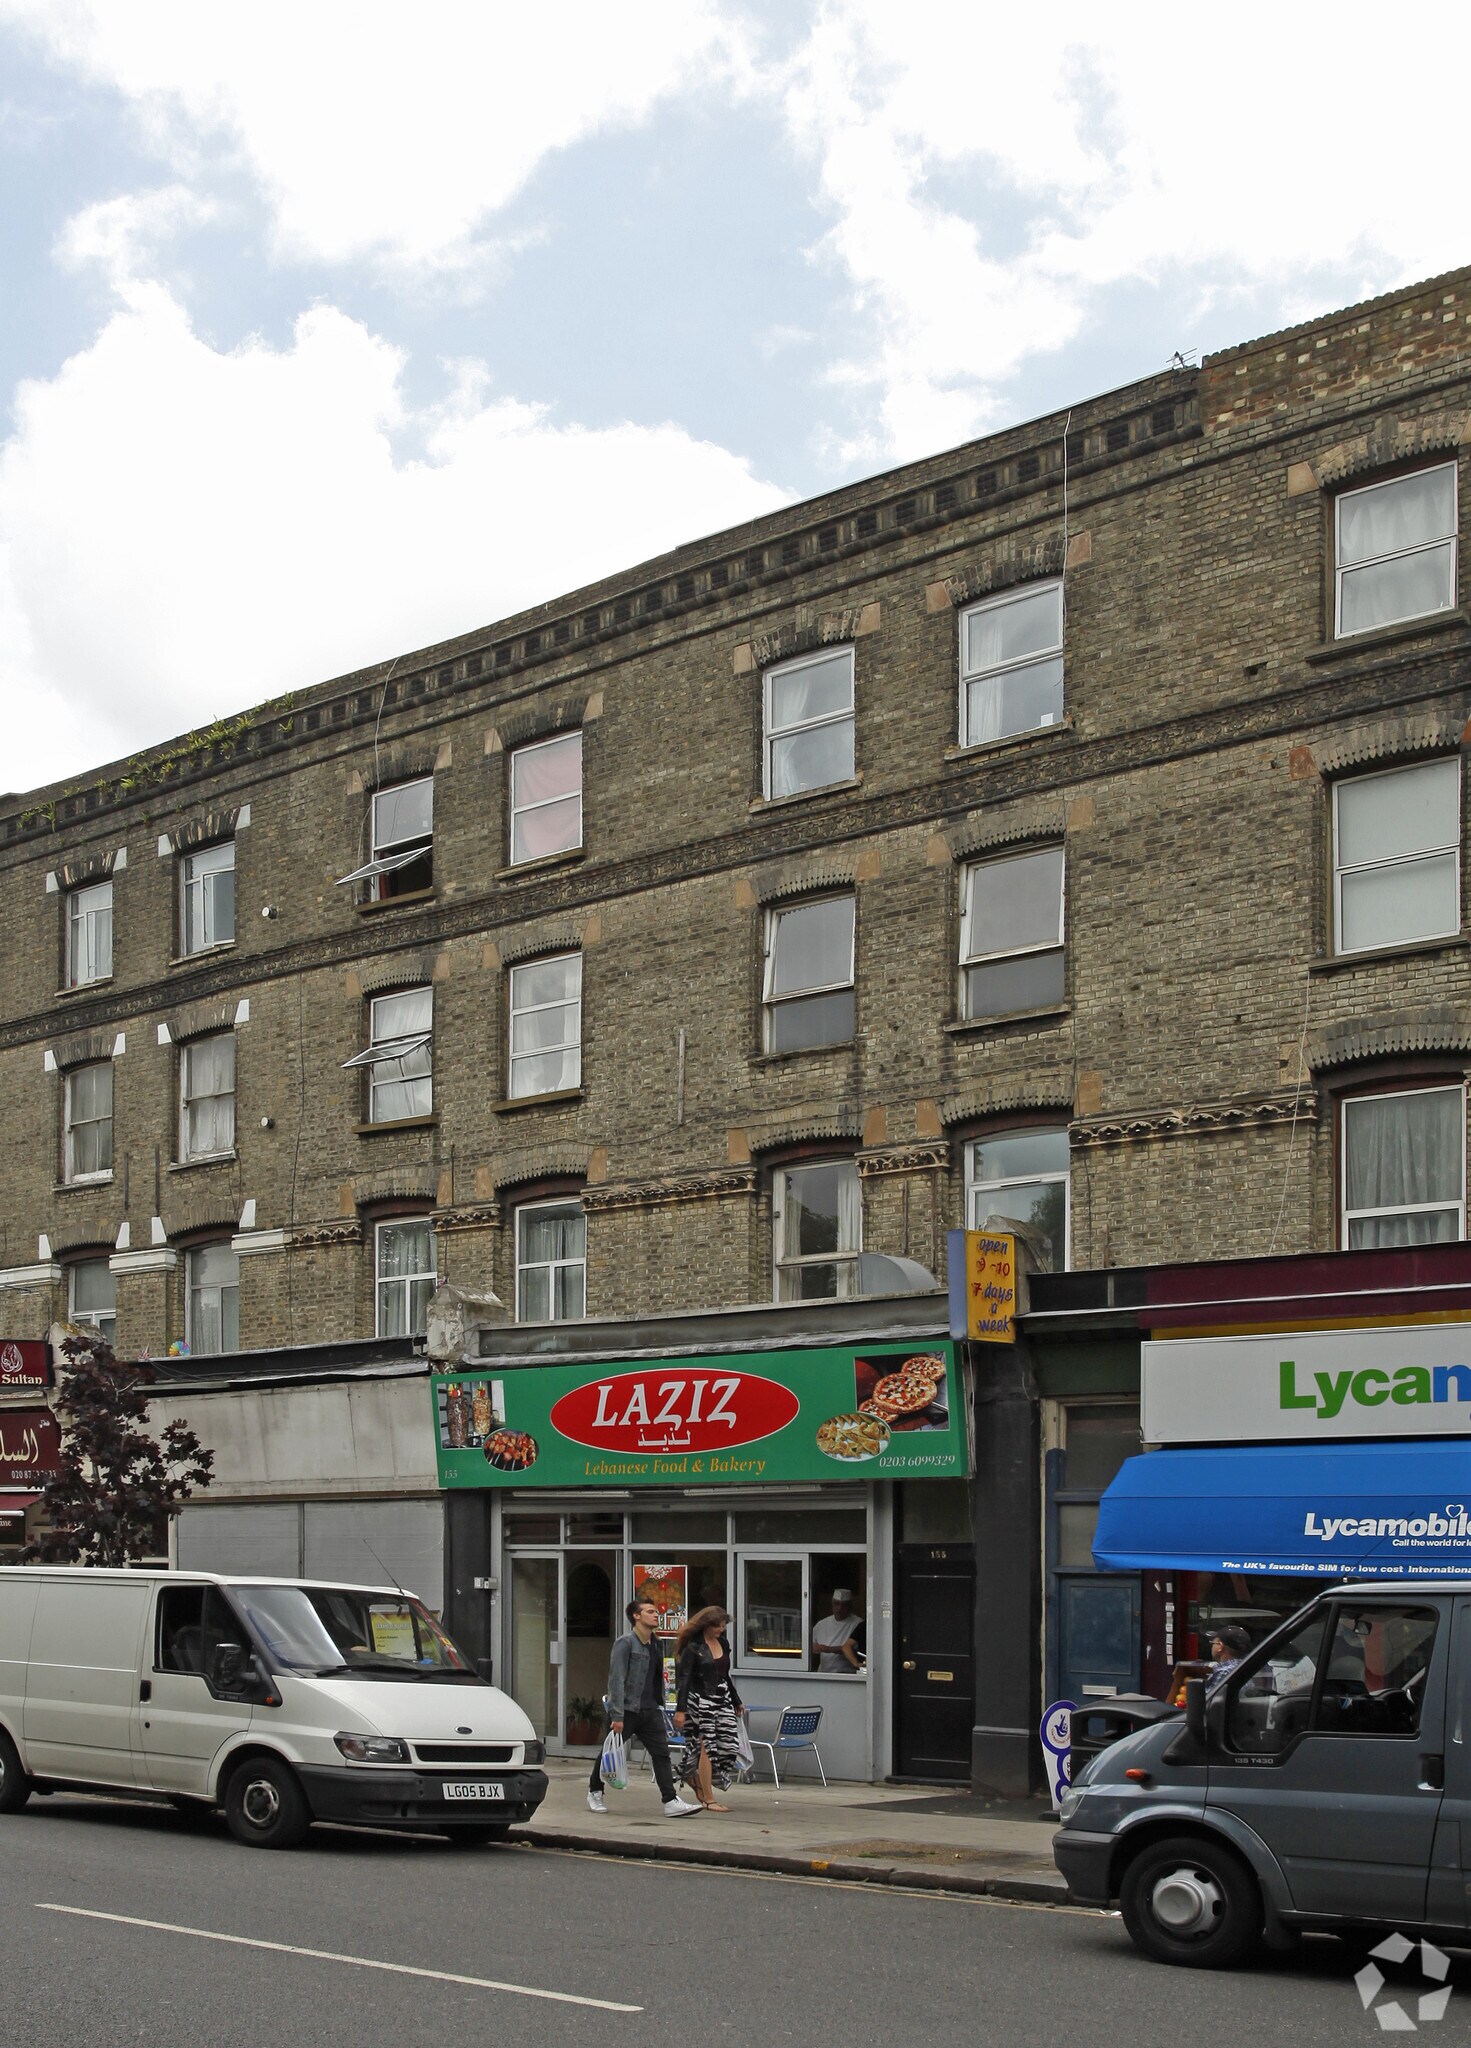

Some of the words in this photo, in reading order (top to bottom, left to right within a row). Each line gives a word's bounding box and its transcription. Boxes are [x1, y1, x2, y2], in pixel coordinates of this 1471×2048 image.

[978, 1239, 1008, 1255] open
[973, 1282, 982, 1297] 7
[984, 1281, 1013, 1304] days
[991, 1302, 998, 1314] a
[979, 1315, 1010, 1333] week
[1, 1373, 43, 1385] Sultan
[592, 1378, 741, 1431] LAZIZ
[638, 1427, 691, 1452] لذيذ
[584, 1460, 648, 1476] Lebanese
[653, 1457, 687, 1474] Food
[691, 1458, 705, 1473] &
[709, 1456, 766, 1476] Bakery
[1304, 1504, 1471, 1541] Lycamobil
[1392, 1539, 1409, 1547] Call
[1410, 1539, 1426, 1547] the
[1426, 1539, 1451, 1547] world
[1452, 1539, 1466, 1547] for
[1243, 1562, 1266, 1570] UK's
[1268, 1563, 1315, 1571] favourite
[1317, 1564, 1337, 1572] SIM
[1340, 1564, 1356, 1572] for
[1380, 1565, 1404, 1573] cost
[447, 1785, 477, 1798] LG05
[478, 1785, 500, 1798] BJX
